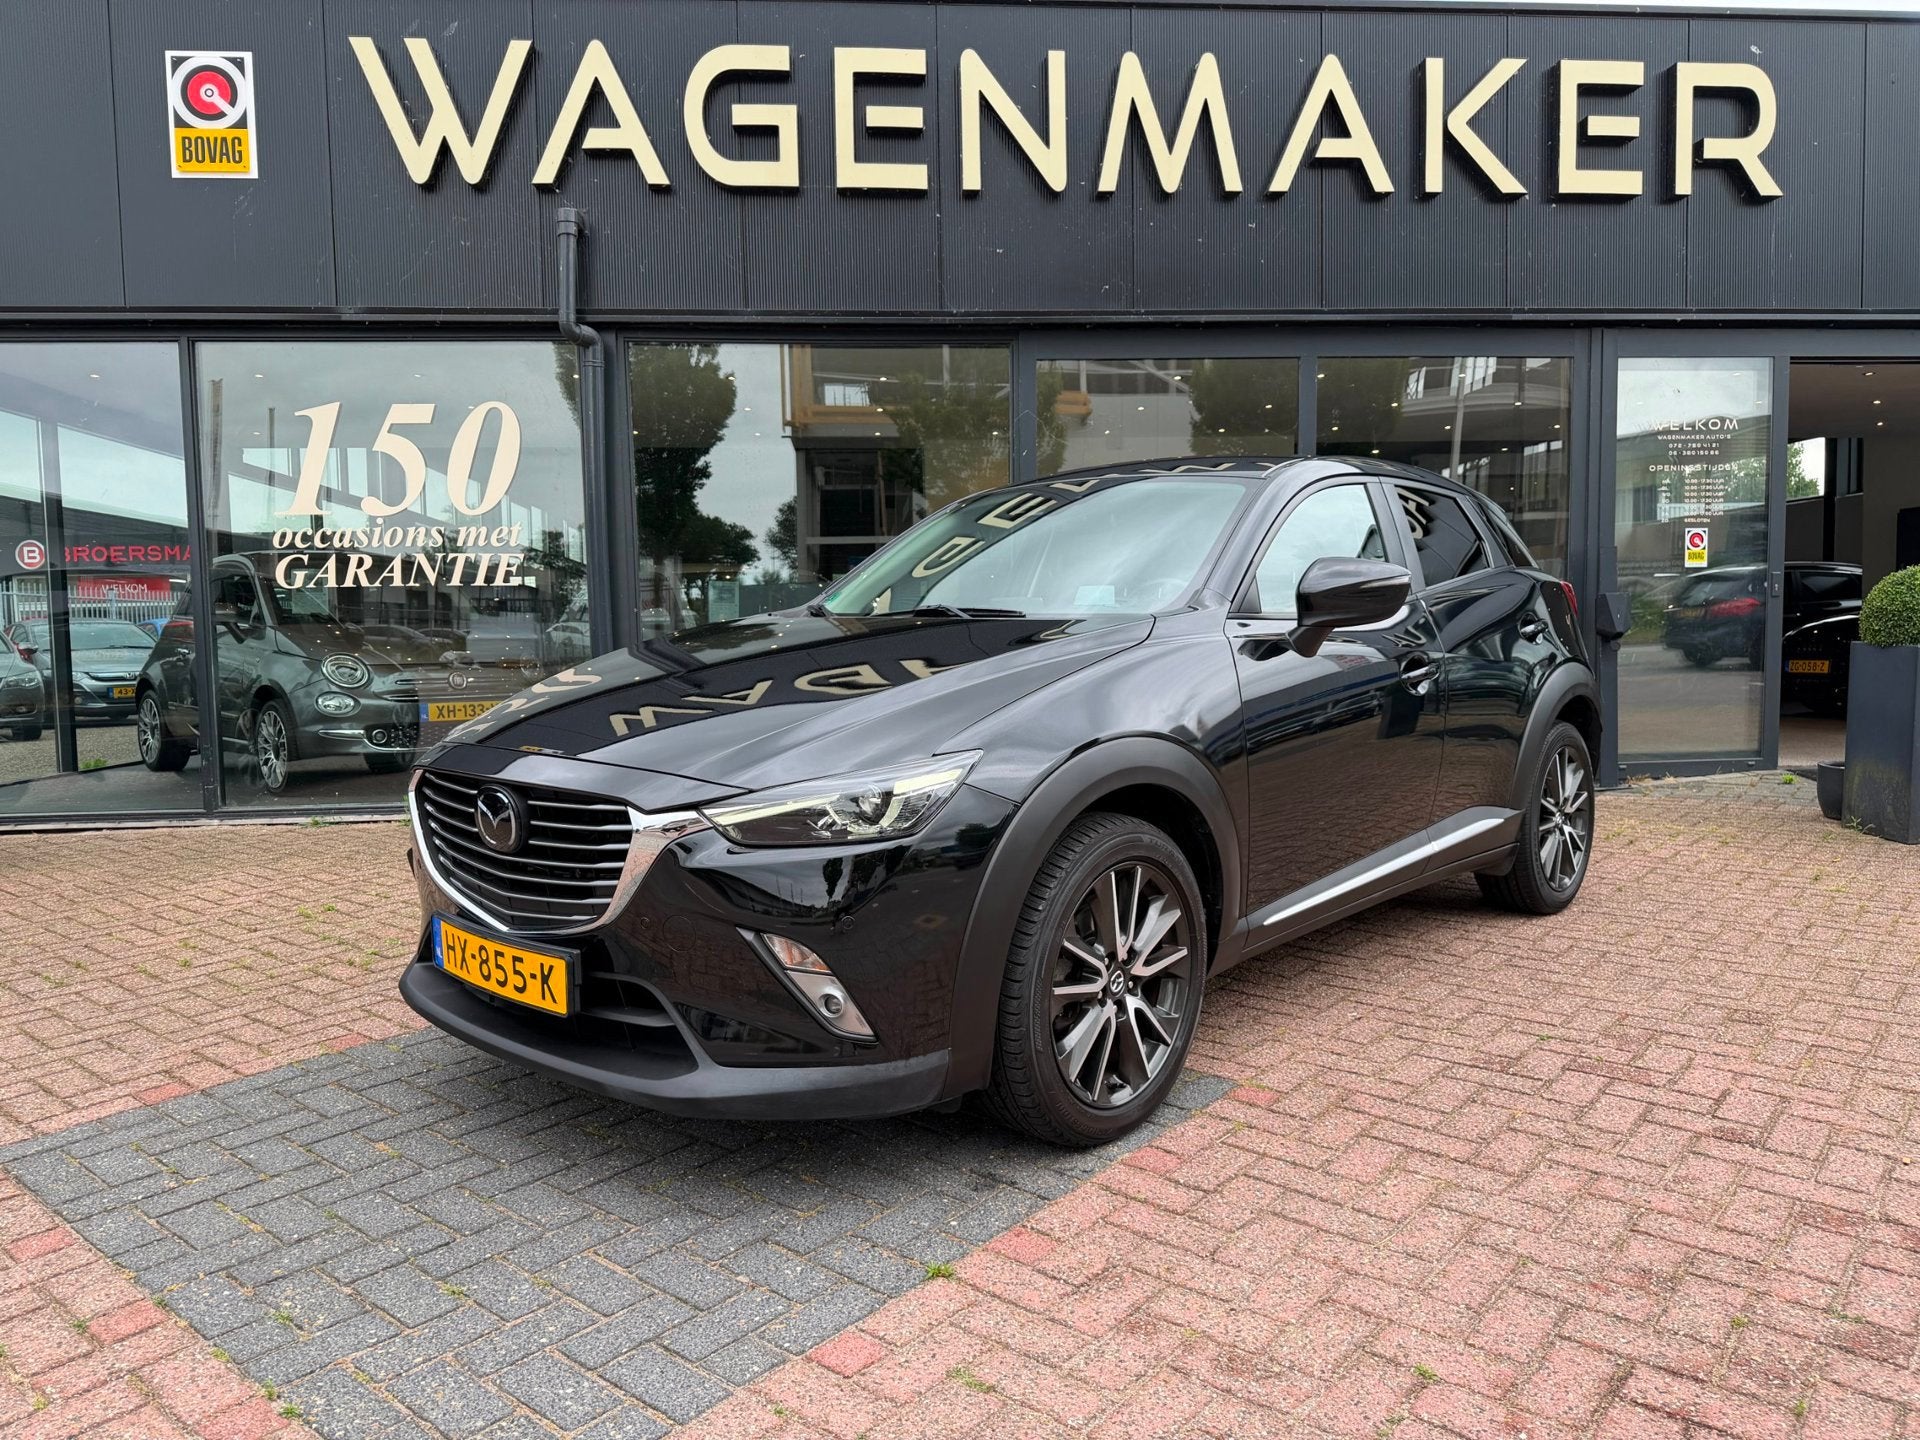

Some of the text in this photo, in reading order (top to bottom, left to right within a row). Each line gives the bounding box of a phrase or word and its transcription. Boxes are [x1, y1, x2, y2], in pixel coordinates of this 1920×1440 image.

[348, 36, 1784, 197] WAGENMAKER
[181, 136, 243, 165] BOVAG
[1652, 418, 1739, 431] WELKOM
[274, 401, 521, 517] 150
[272, 517, 523, 549] occasions met
[274, 552, 525, 590] GARANTIE
[1687, 551, 1705, 560] BOVAG
[436, 702, 497, 719] XH-133-
[444, 929, 558, 1004] HX-855-K
